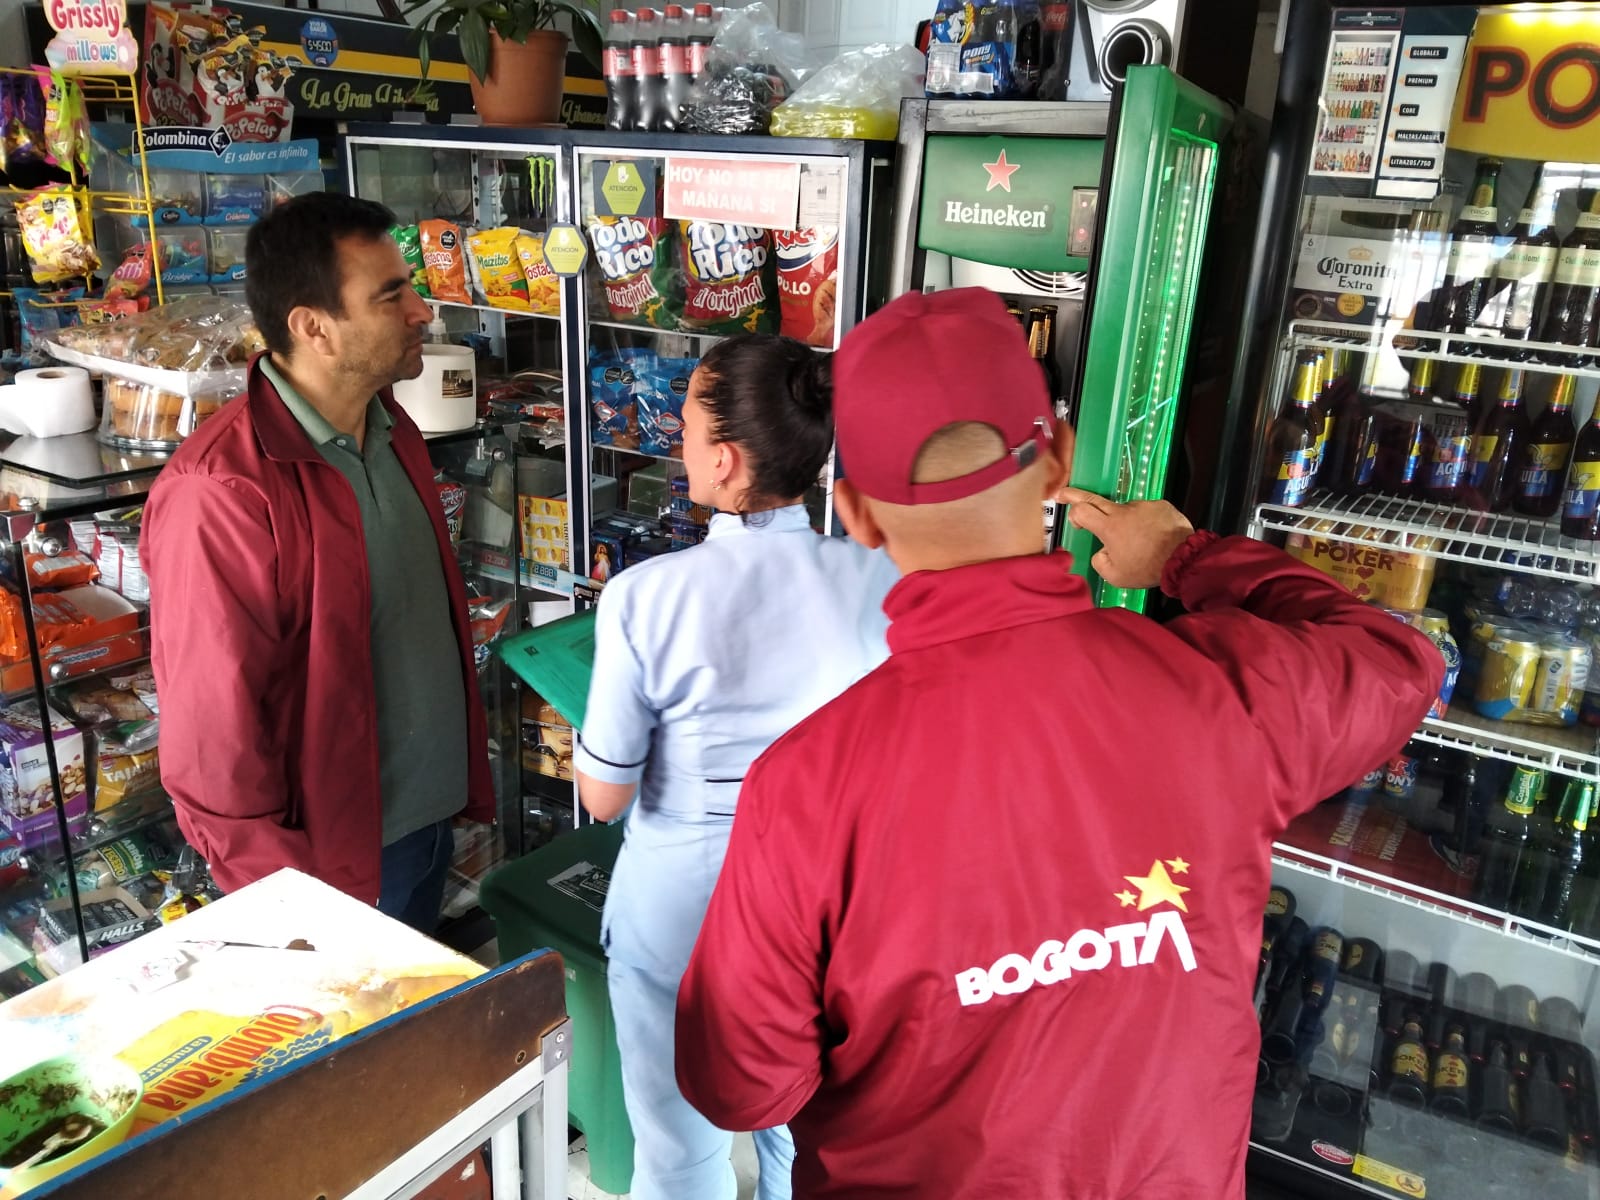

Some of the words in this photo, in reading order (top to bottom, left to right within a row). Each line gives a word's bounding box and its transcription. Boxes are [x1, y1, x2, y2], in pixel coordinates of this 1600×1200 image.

[51, 0, 119, 37] Grissly
[67, 40, 116, 60] millows
[334, 82, 373, 111] Gran
[225, 152, 235, 163] El
[238, 149, 265, 162] sabor
[267, 151, 277, 159] es
[279, 146, 308, 159] infinito
[669, 165, 704, 184] HOY
[708, 168, 731, 186] NO
[945, 201, 1046, 228] Heineken
[1307, 238, 1314, 247] 6
[476, 255, 509, 268] Maizitos
[1338, 276, 1373, 291] Extra
[1314, 541, 1395, 571] POKER
[1387, 774, 1415, 787] ONY
[101, 921, 145, 941] HALLS
[142, 1043, 190, 1079] nuestr
